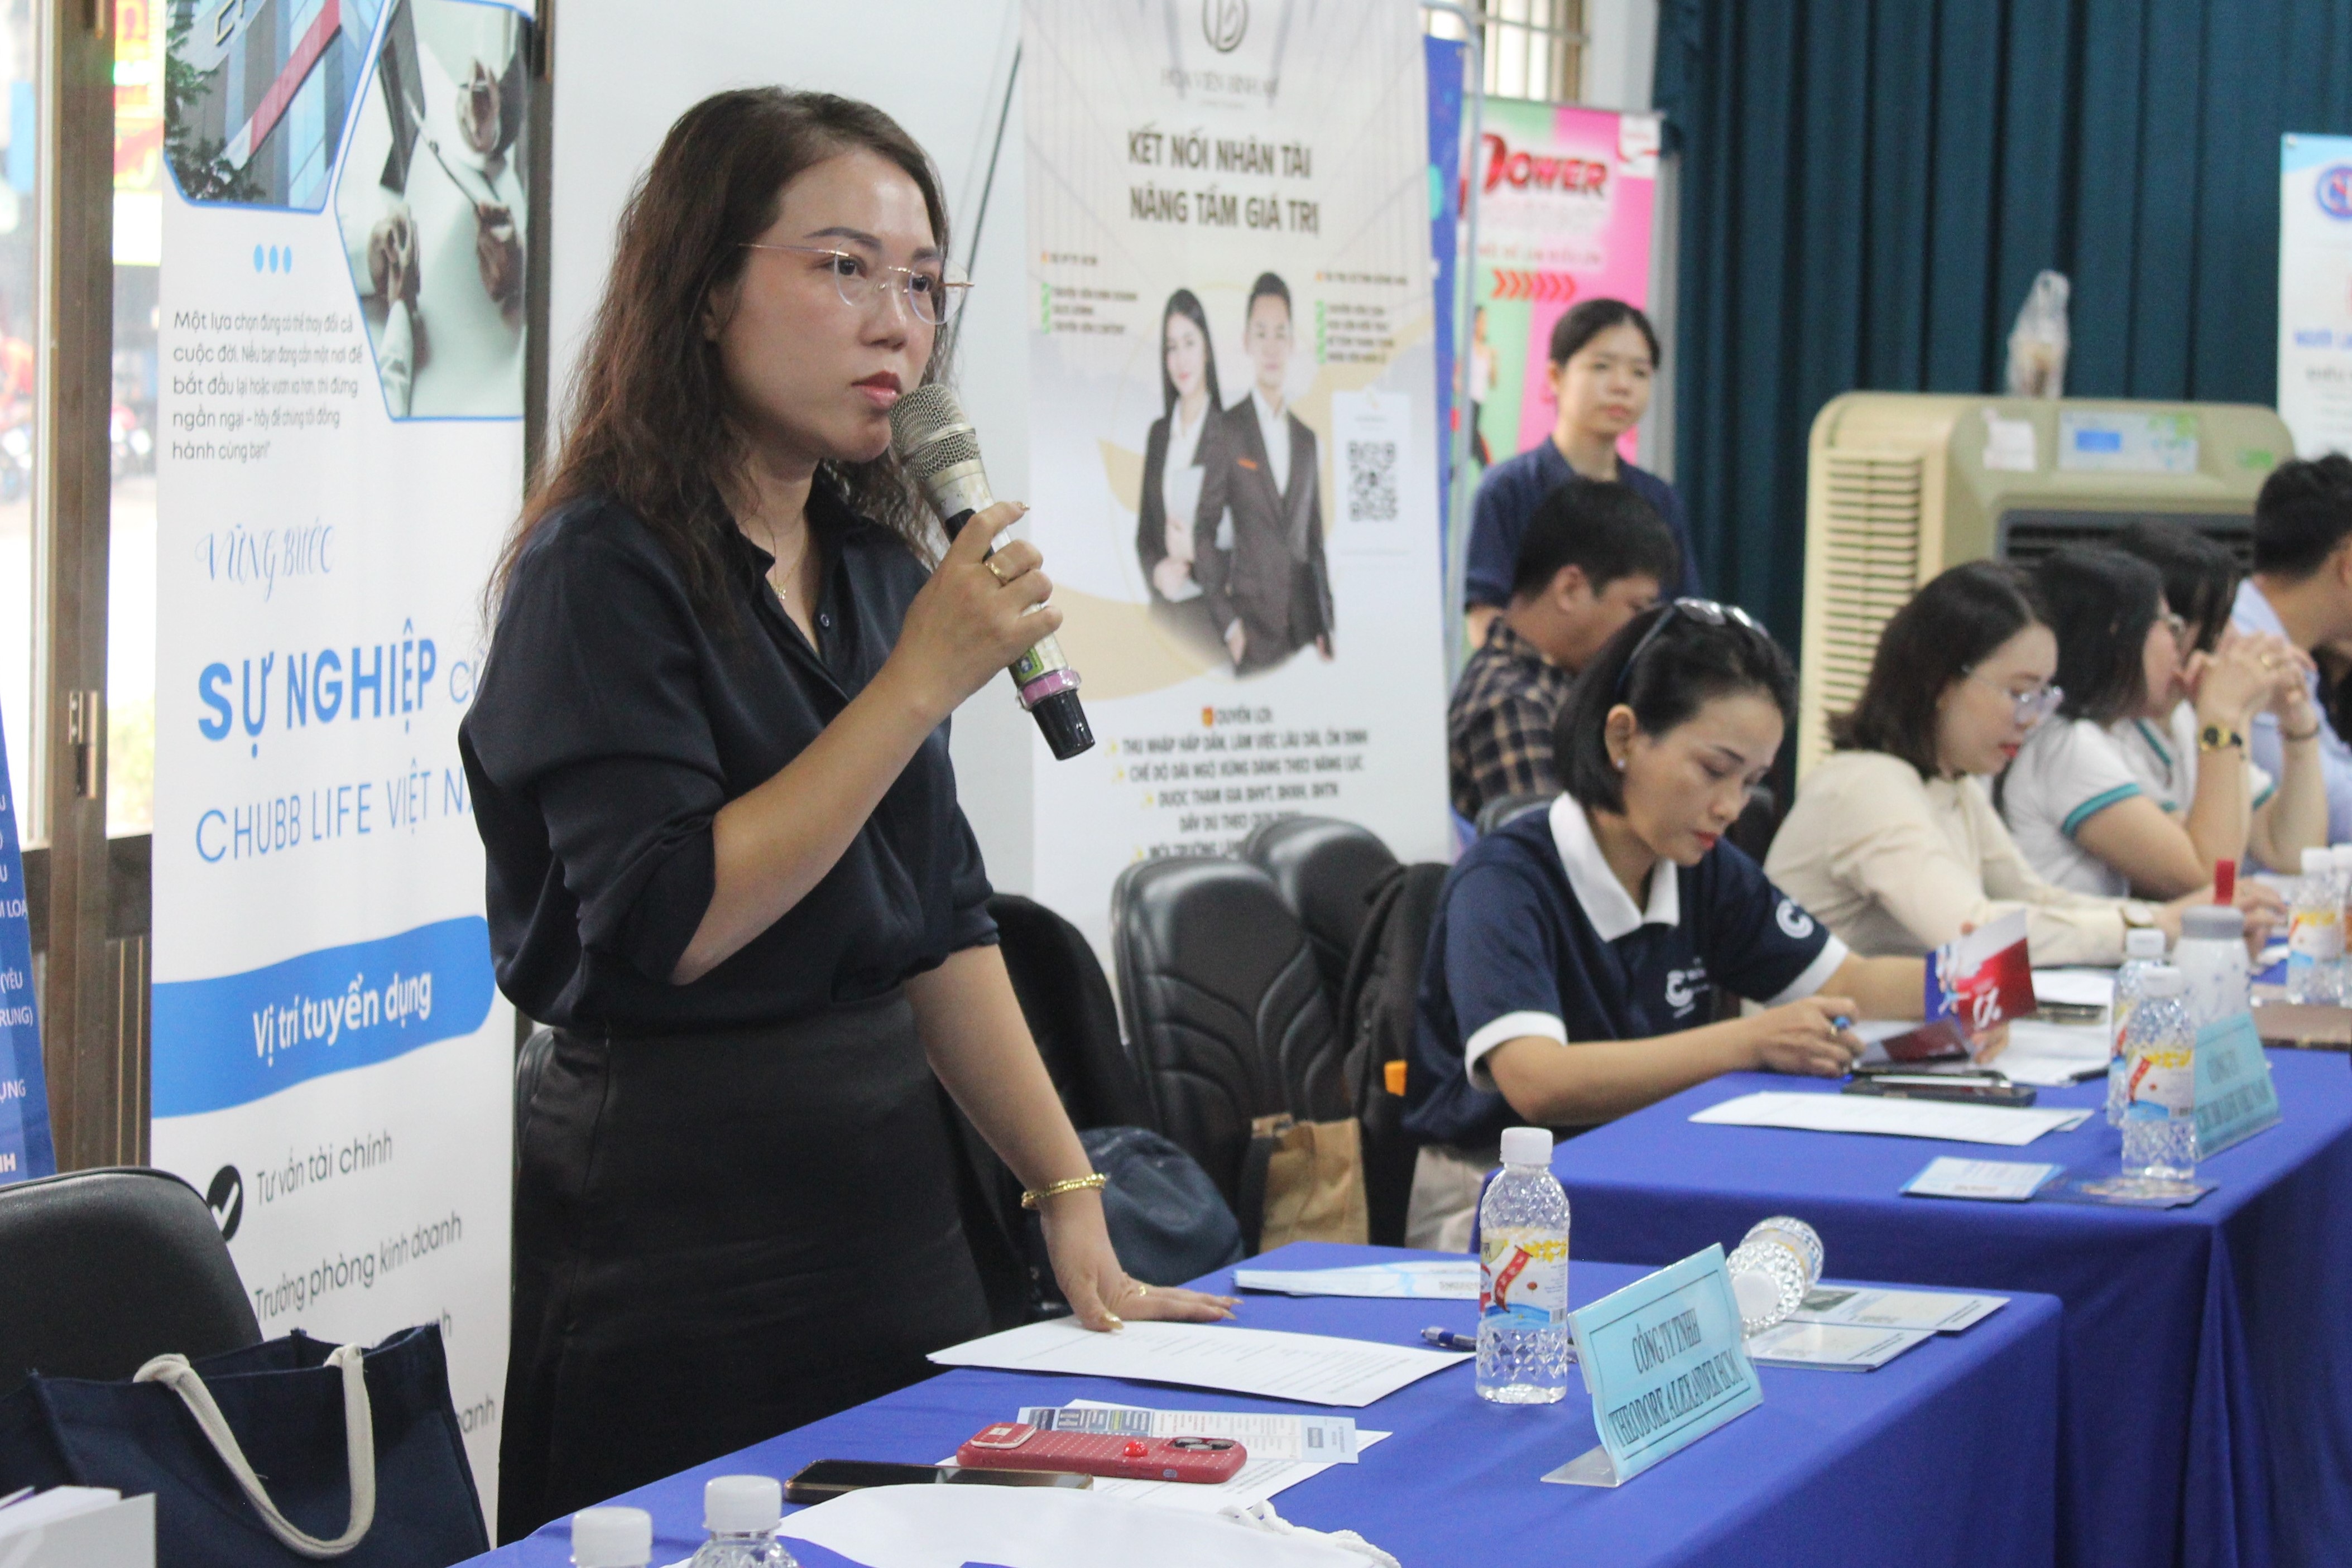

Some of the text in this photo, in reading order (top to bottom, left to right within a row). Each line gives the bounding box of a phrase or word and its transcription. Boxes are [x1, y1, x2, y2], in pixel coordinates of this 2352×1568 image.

[1129, 121, 1311, 179] KẾT NỐI NHÂN TÀI
[1130, 180, 1319, 238] NÂNG TẦM GIÁ TRỊ
[174, 310, 207, 333] Một
[211, 312, 231, 334] lựa
[234, 311, 258, 334] chọn
[174, 342, 214, 366] cuộc
[242, 339, 260, 363] Nếu
[348, 343, 363, 364] để
[174, 370, 206, 395] bắt
[208, 371, 233, 395] đầu
[237, 376, 247, 398] lại
[174, 403, 215, 431] ngần
[220, 408, 244, 431] ngại
[174, 440, 215, 460] hành
[218, 440, 247, 463] cùng
[198, 651, 275, 759] SỰ
[287, 617, 437, 734] NGHIỆP
[196, 757, 473, 863] CHUBB LIFE VIỆT N
[253, 971, 432, 1067] Vị trí tuyển dụng
[257, 1129, 392, 1206] Tư vấn tài chính
[255, 1209, 462, 1322] Trưởng phòng kinh doanh
[1633, 1323, 1664, 1374] CÔNG
[1658, 1320, 1676, 1359] TY
[1608, 1387, 1671, 1447] THEODORE
[1667, 1360, 1724, 1420] ALEXANDER
